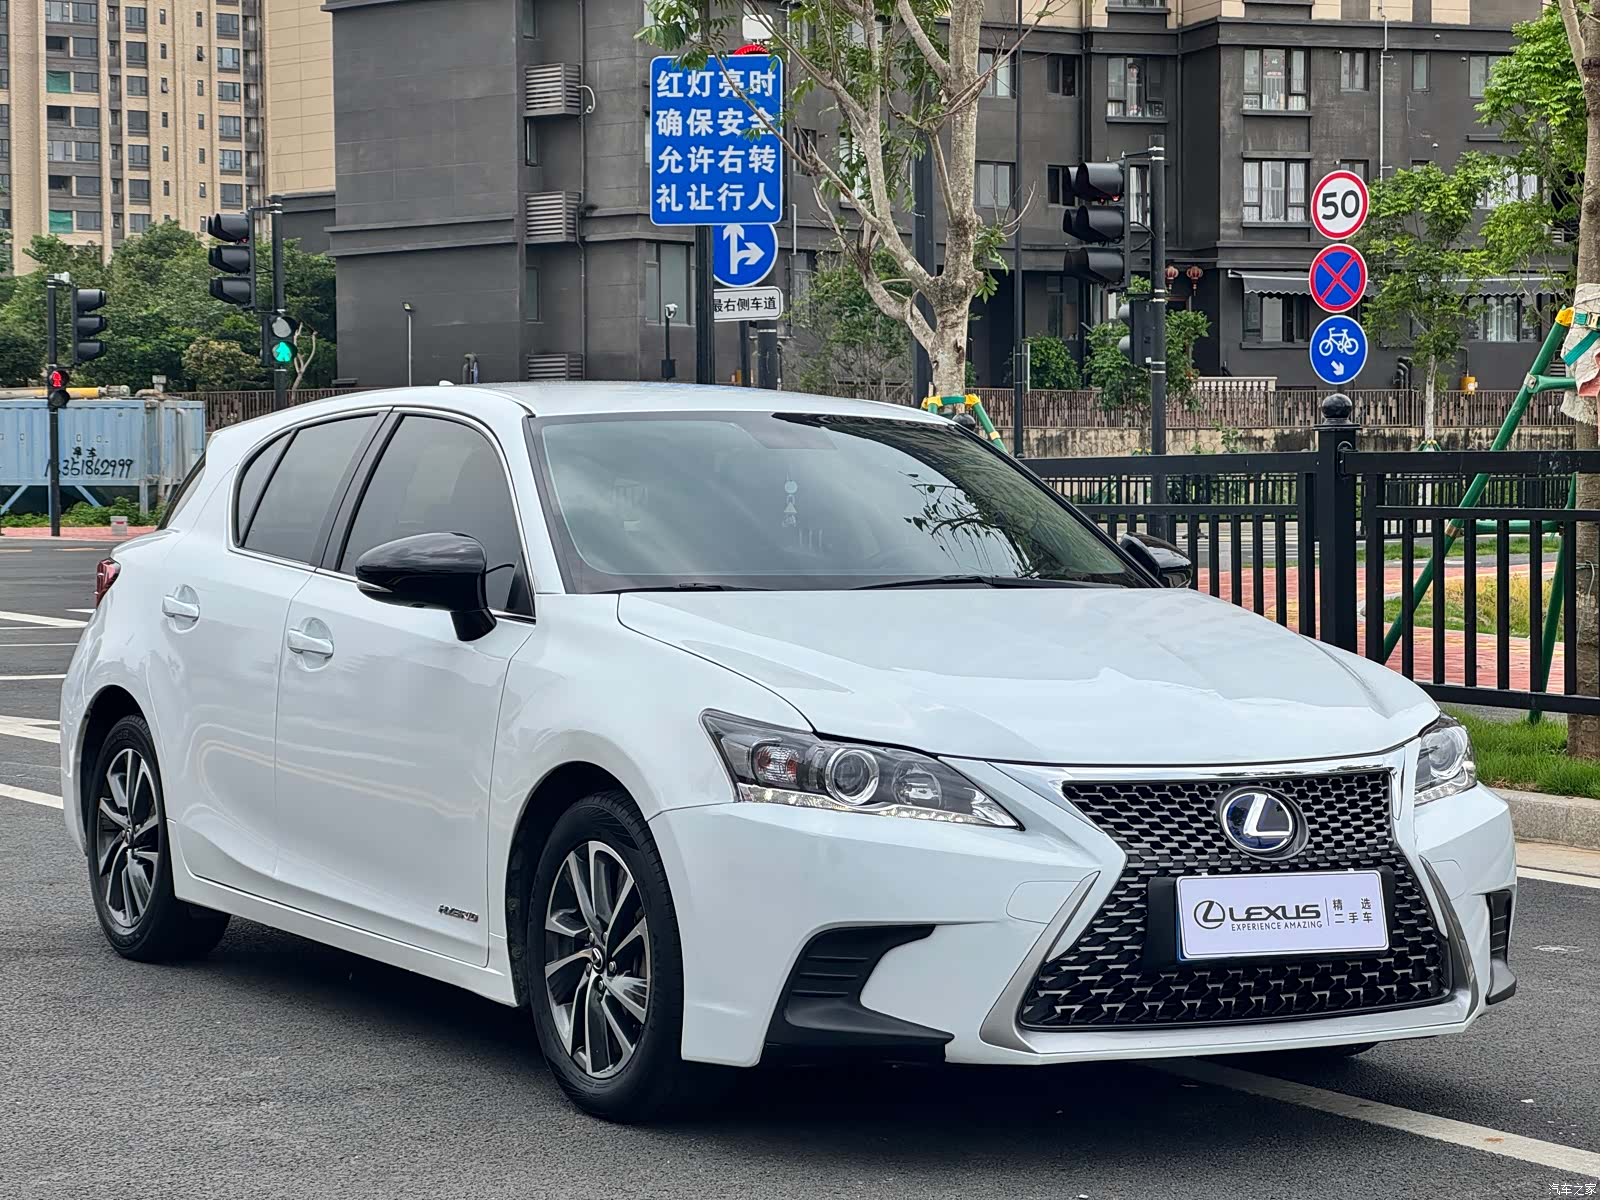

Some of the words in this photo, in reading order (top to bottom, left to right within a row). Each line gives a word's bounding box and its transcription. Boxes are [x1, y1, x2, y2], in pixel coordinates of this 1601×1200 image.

[656, 68, 777, 98] 红灯亮时
[655, 106, 776, 137] 确保安全
[656, 144, 777, 174] 允许右转
[656, 182, 776, 212] 礼让行人
[1321, 189, 1360, 220] 50
[44, 457, 134, 478] 1351862999
[1228, 904, 1322, 922] LEXUS
[1332, 897, 1372, 911] 精选
[1231, 922, 1282, 932] EXPERIENCE
[1284, 921, 1322, 930] AMAZING
[1334, 911, 1373, 924] 二手车
